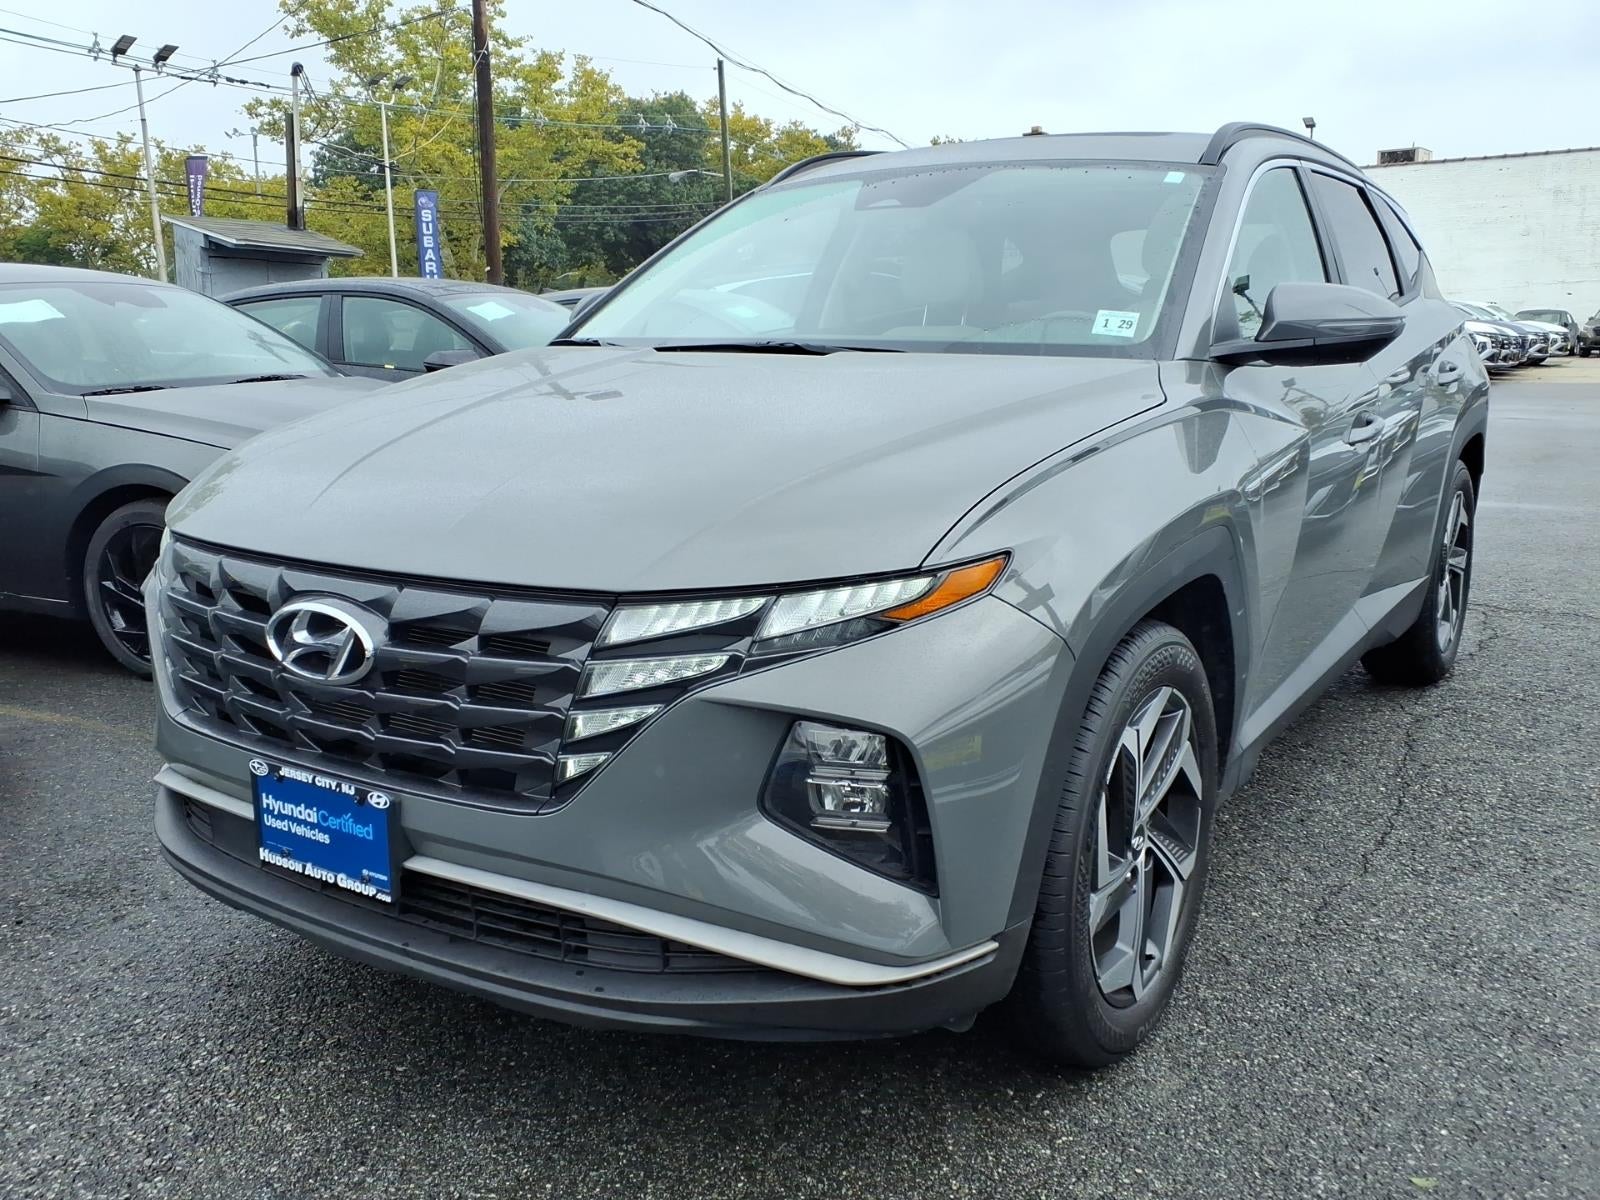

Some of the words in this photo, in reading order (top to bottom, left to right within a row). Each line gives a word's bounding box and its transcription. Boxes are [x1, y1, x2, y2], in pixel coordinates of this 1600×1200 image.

[1103, 318, 1109, 328] 1
[1118, 320, 1133, 329] 29
[279, 766, 313, 784] JERSEY
[315, 776, 340, 792] CITY,
[341, 783, 355, 796] NJ
[262, 793, 318, 824] Hyundai
[318, 812, 373, 841] Certified
[264, 813, 289, 832] Used
[289, 821, 330, 845] Vehicles
